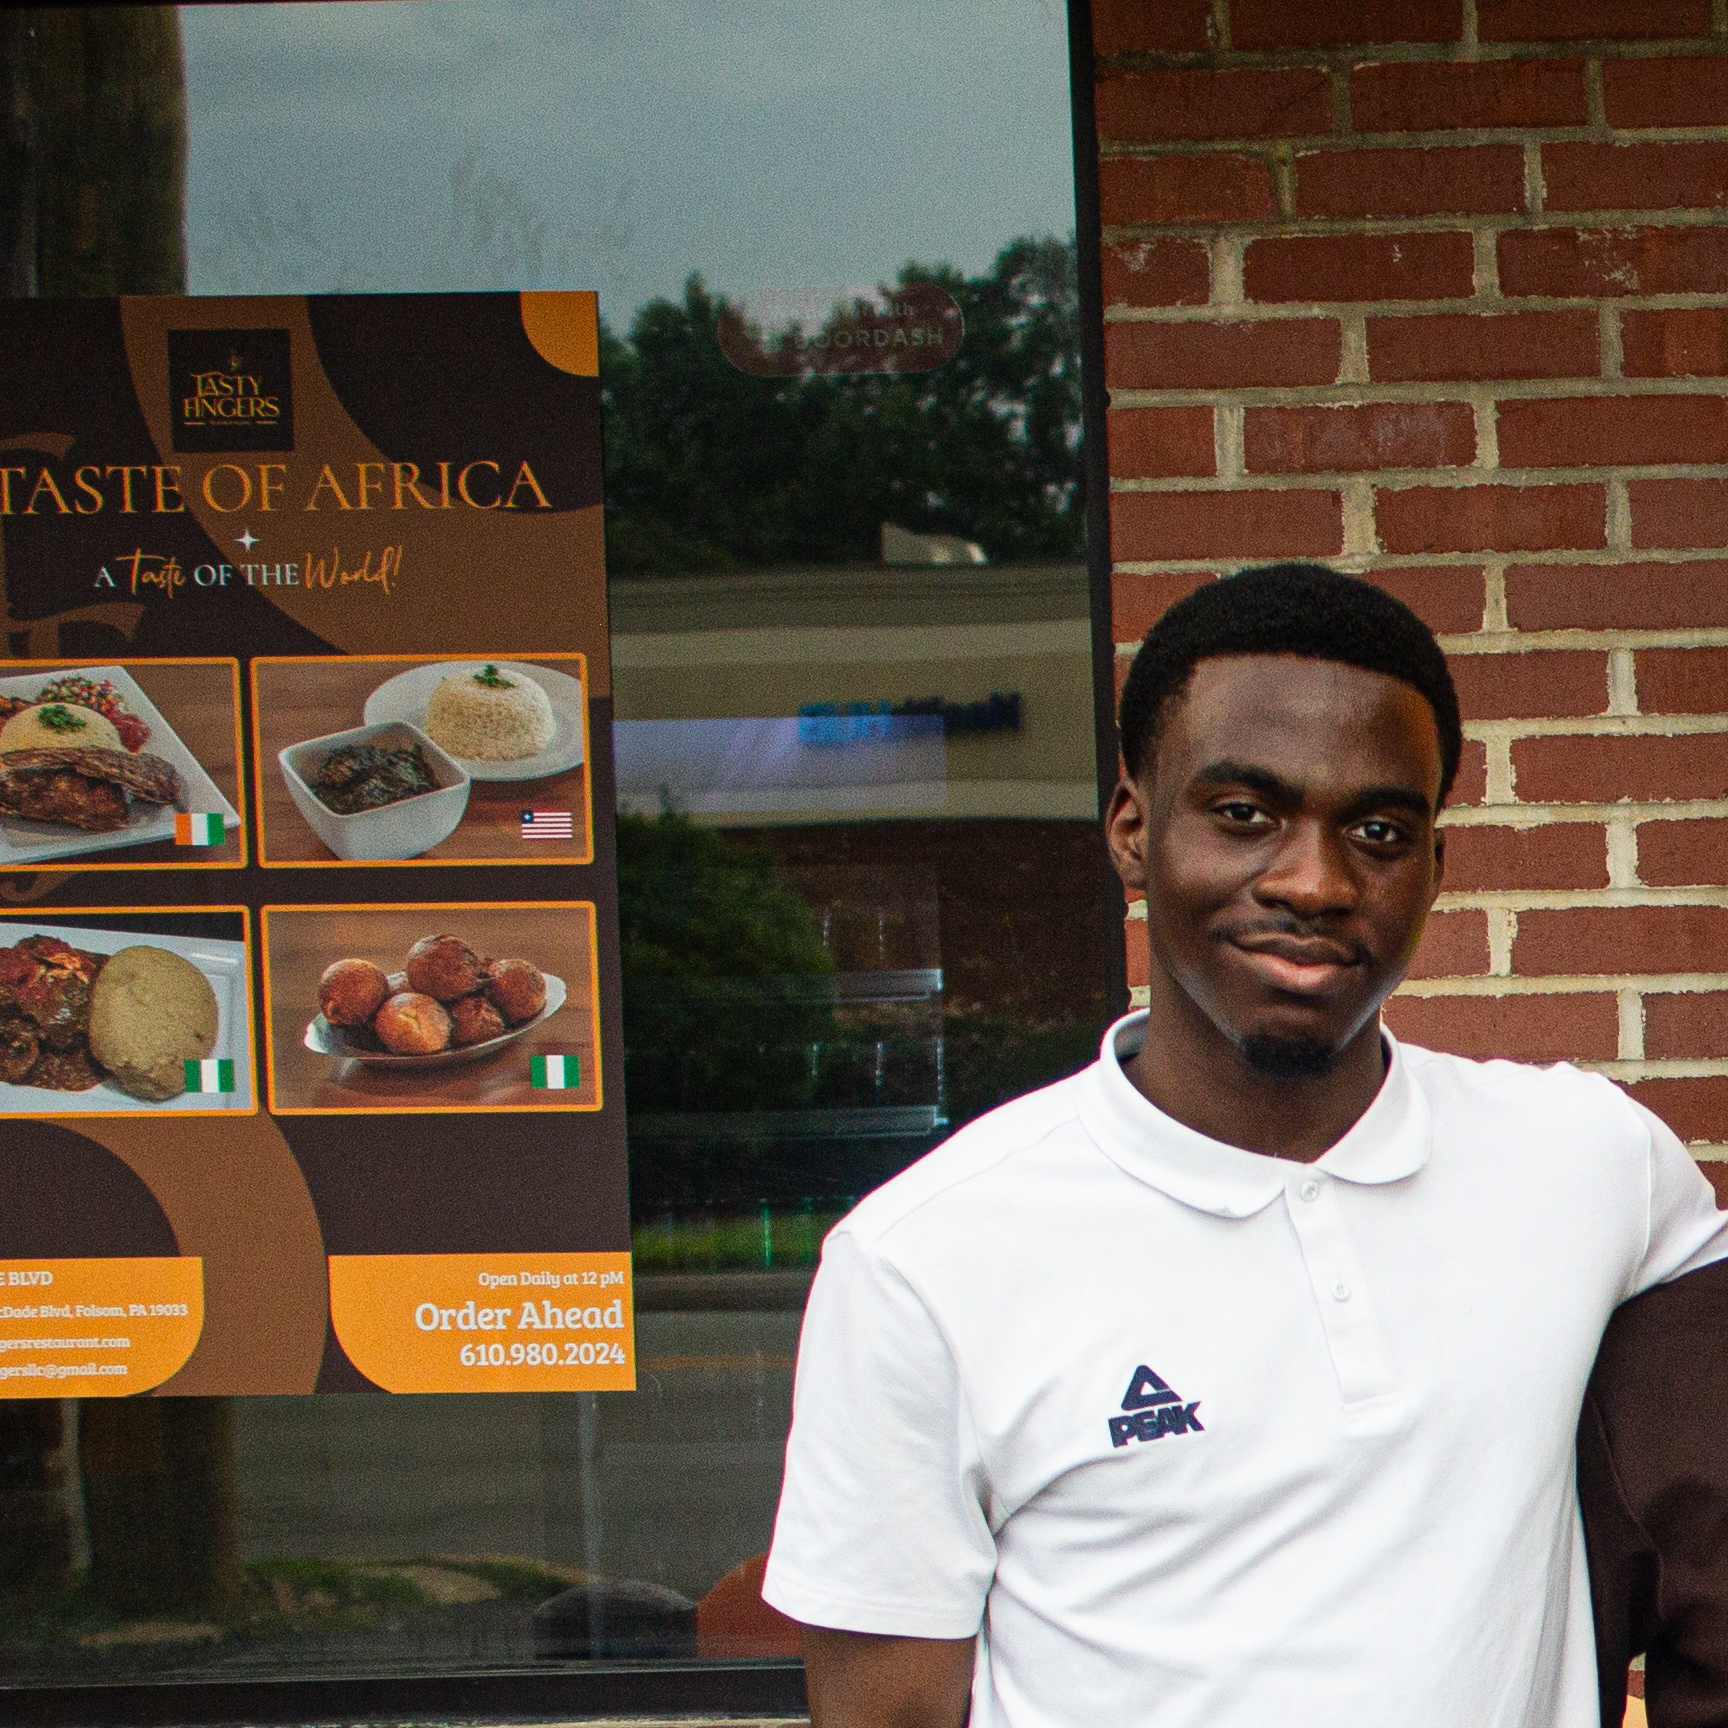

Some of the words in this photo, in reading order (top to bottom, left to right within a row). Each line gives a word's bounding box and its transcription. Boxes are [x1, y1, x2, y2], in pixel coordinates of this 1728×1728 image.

[190, 371, 261, 396] TASTY
[183, 396, 279, 417] FINGERS
[0, 465, 186, 515] TASTE
[202, 463, 286, 513] OF
[304, 460, 552, 511] AFRICA
[94, 566, 116, 587] A
[115, 547, 186, 599] Taste
[194, 564, 233, 586] OF
[240, 562, 299, 585] THE
[8, 1271, 54, 1286] BLVD
[478, 1272, 518, 1289] Open
[520, 1271, 560, 1289] Daily
[563, 1272, 578, 1285] at
[582, 1271, 597, 1285] 12
[129, 1304, 147, 1316] PA
[150, 1303, 189, 1317] 19033
[414, 1301, 511, 1331] Order
[517, 1299, 625, 1330] Ahead
[459, 1342, 626, 1366] 610.980.2024
